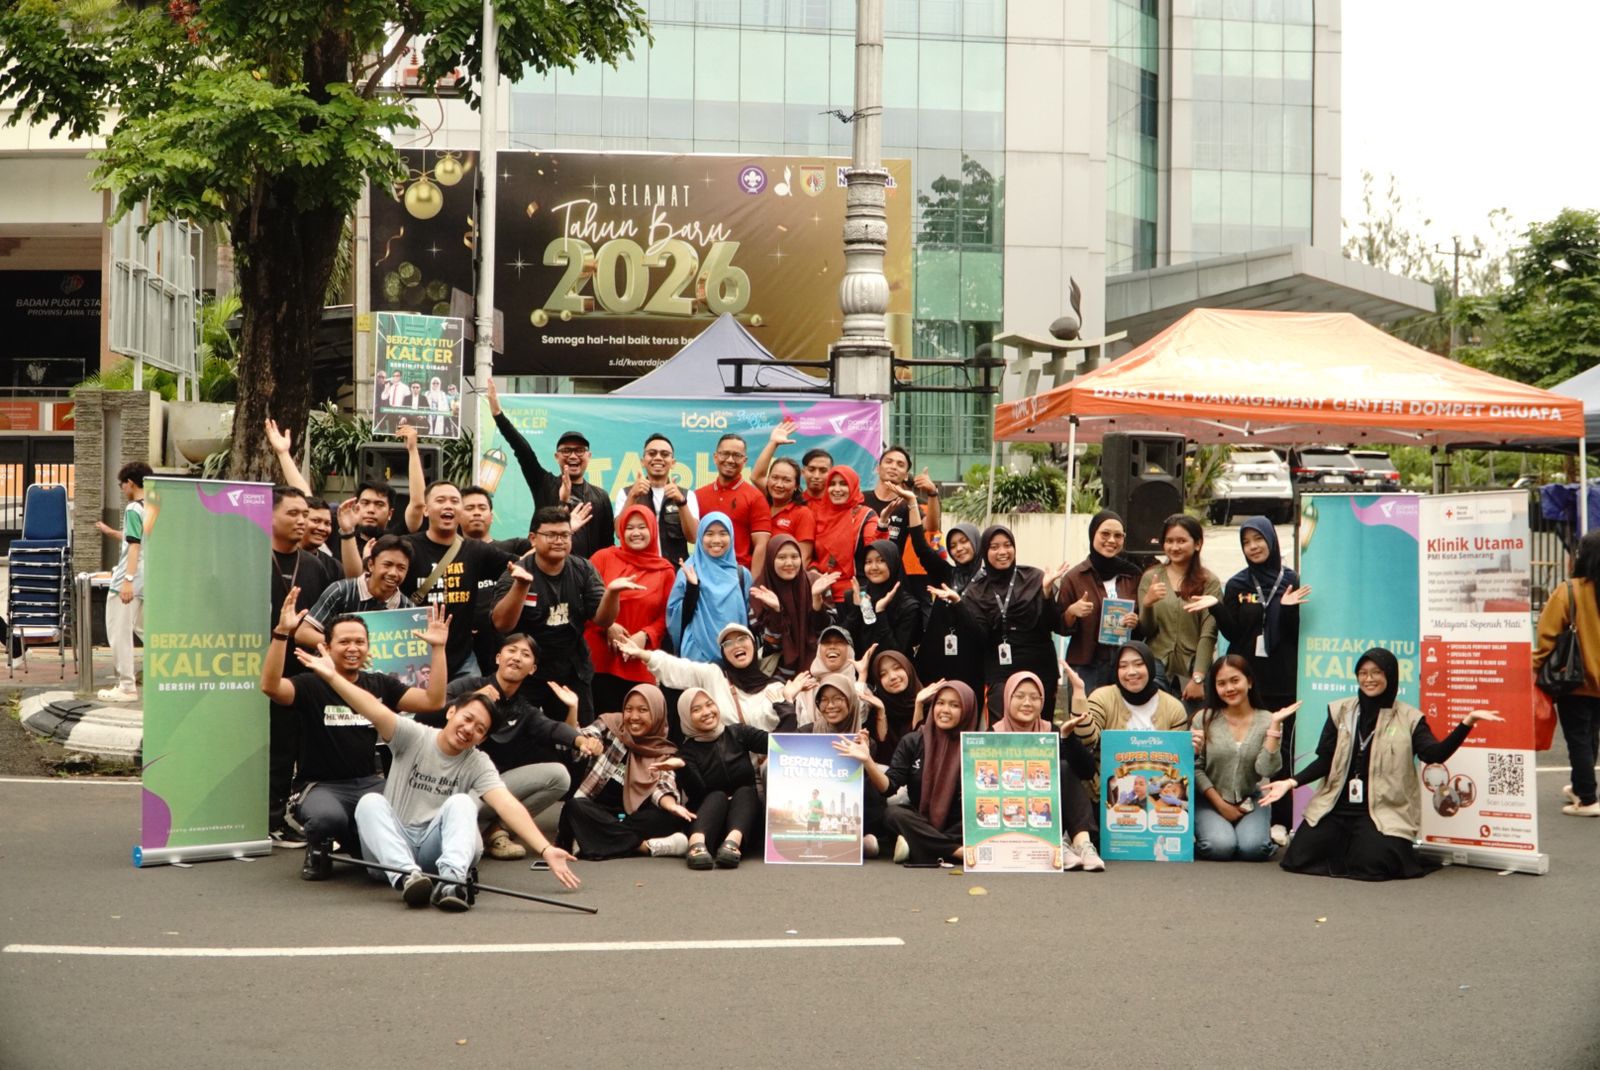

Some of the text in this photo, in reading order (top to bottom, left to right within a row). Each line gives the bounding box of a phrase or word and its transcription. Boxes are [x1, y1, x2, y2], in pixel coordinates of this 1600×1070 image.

[609, 184, 690, 207] SELAMAT
[551, 198, 731, 256] Tahun Baru
[542, 237, 750, 316] 2026
[16, 298, 49, 307] BADAN
[50, 298, 82, 307] PUSAT
[27, 308, 62, 316] PROVINSI
[64, 308, 84, 316] JAWA
[386, 335, 454, 348] BERZAKAT ITU
[541, 335, 585, 347] Semoga
[587, 335, 626, 345] hal-hal
[628, 336, 650, 345] baik
[652, 336, 679, 345] terus
[385, 345, 453, 364] KALCER
[1191, 391, 1325, 410] MANAGEMENT
[1332, 397, 1403, 415] CENTER
[1409, 400, 1485, 417] DOMPET
[1489, 404, 1563, 421] DHUAFA
[1427, 537, 1524, 552] Klinik Utama
[1427, 553, 1440, 561] PMI
[1459, 552, 1494, 561] Semarang
[1469, 619, 1502, 631] Sepenuh
[150, 633, 262, 649] BERZAKAT ITU
[1306, 636, 1414, 655] BERZAKAT ITU
[369, 640, 428, 660] ALCER
[150, 652, 262, 677] KALCER
[1305, 655, 1413, 683] KALR
[158, 681, 254, 691] BERSIH ITU DIBAGI
[1311, 682, 1346, 692] BERSIH
[1115, 751, 1149, 762] SUPER
